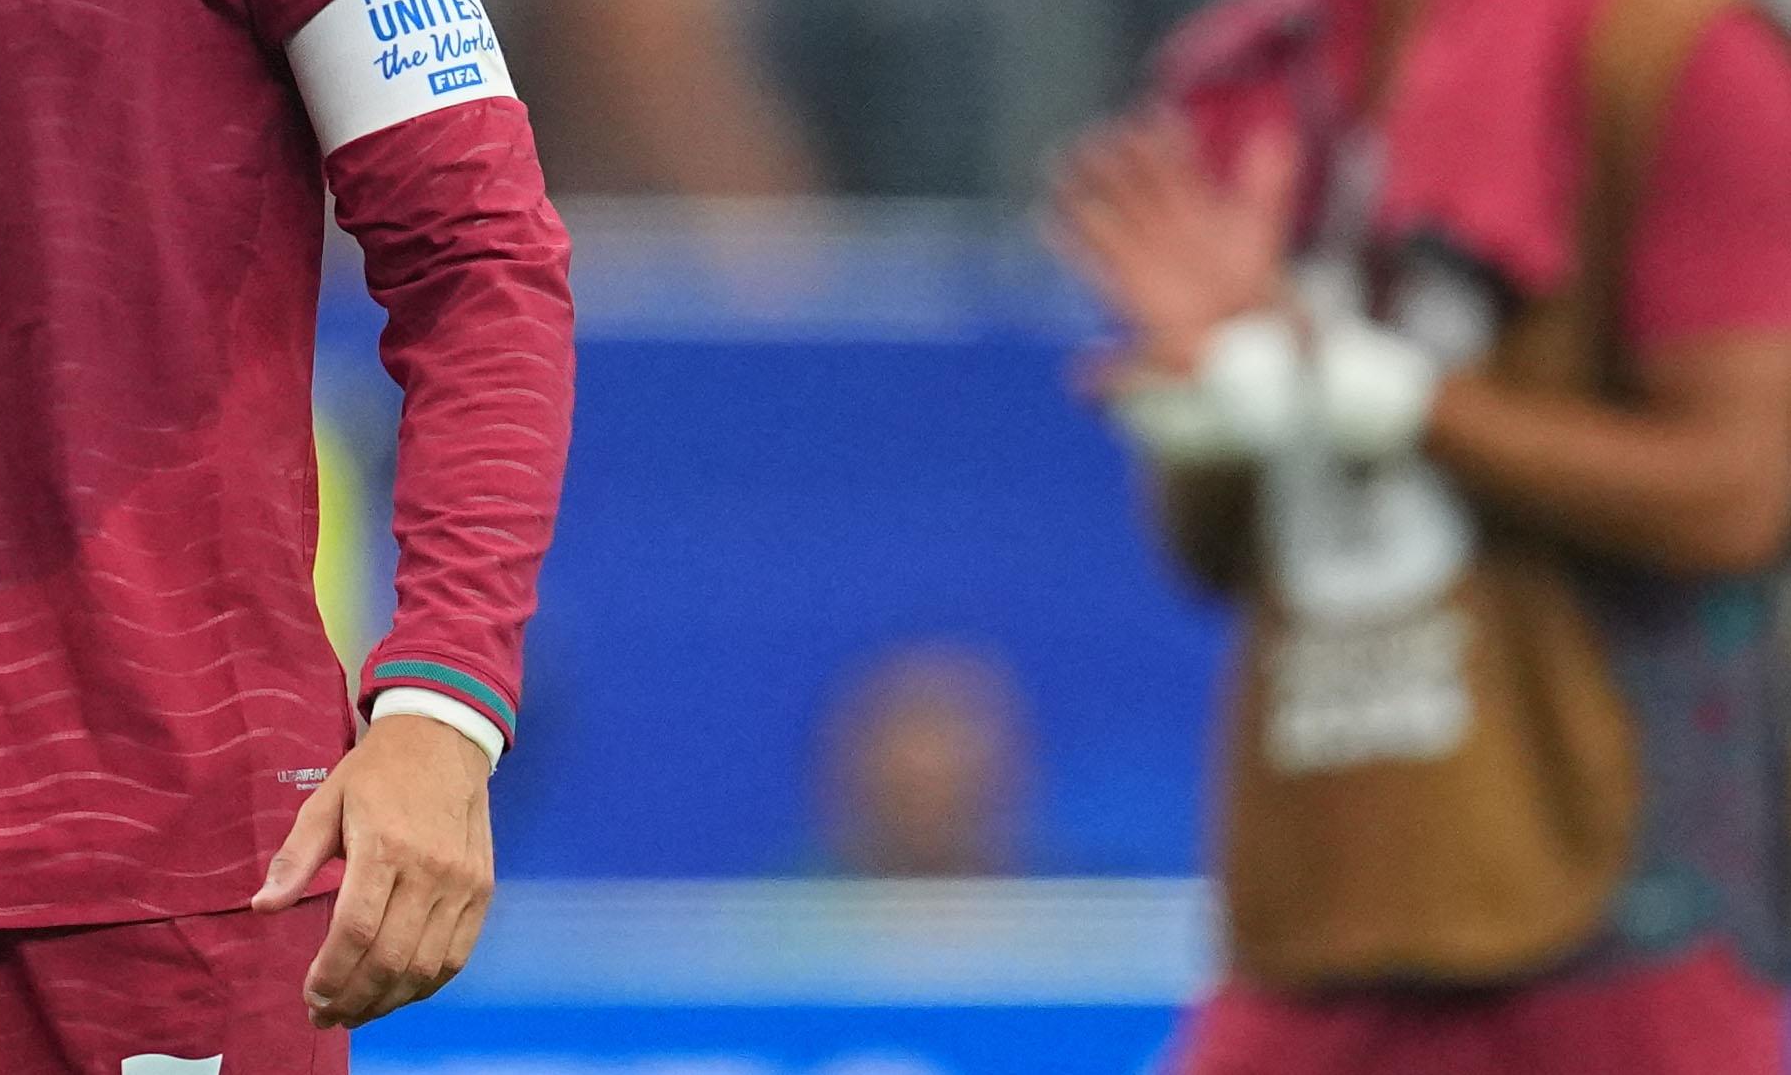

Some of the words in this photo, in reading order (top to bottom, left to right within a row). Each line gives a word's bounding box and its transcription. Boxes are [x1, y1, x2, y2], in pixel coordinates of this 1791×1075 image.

[373, 43, 428, 81] the
[430, 21, 497, 62] World
[432, 66, 482, 93] FIFA
